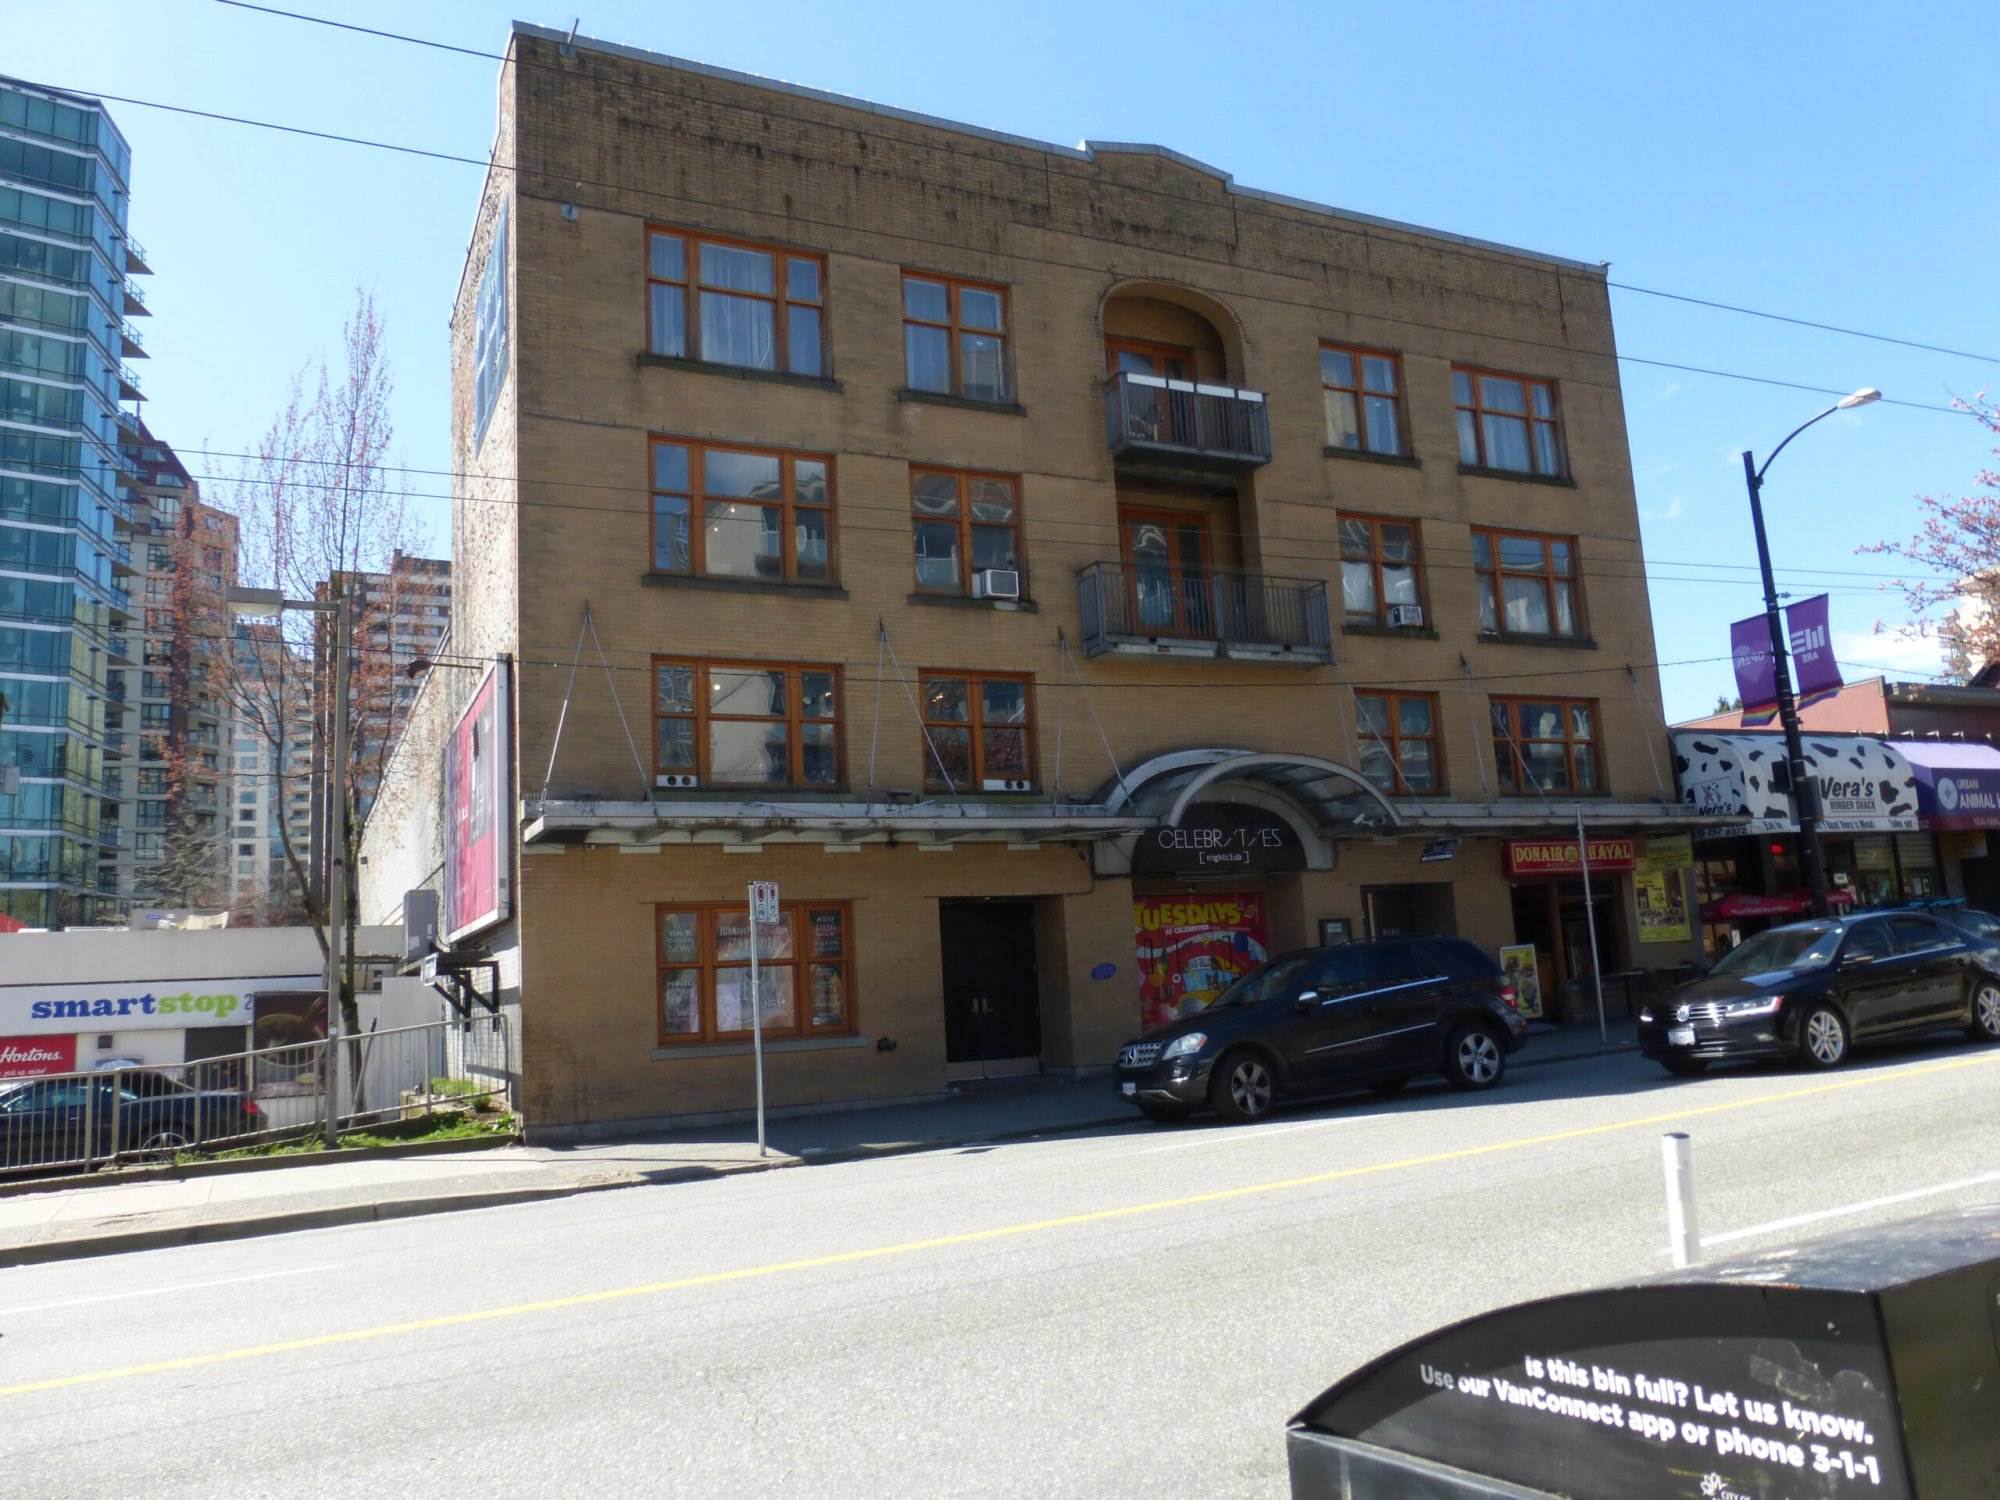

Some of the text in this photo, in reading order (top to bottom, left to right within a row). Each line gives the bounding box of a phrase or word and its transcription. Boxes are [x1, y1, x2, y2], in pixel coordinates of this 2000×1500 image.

[1820, 776, 1873, 799] Vera's
[1699, 801, 1733, 816] Vera's
[1830, 800, 1876, 810] BURGER SHACK
[1959, 793, 1996, 809] ANIMAL
[1514, 845, 1564, 863] DONAIR
[1579, 843, 1632, 861] HAYAL
[1134, 901, 1240, 931] TUESDAYS
[1547, 1358, 1590, 1388] this
[1592, 1365, 1631, 1396] bin
[1634, 1373, 1689, 1407] full?
[1694, 1385, 1739, 1418] Let
[1744, 1400, 1778, 1425] us
[1782, 1400, 1875, 1445] know.
[1420, 1364, 1881, 1485] Use our VanConnect app or phone 3-1-1
